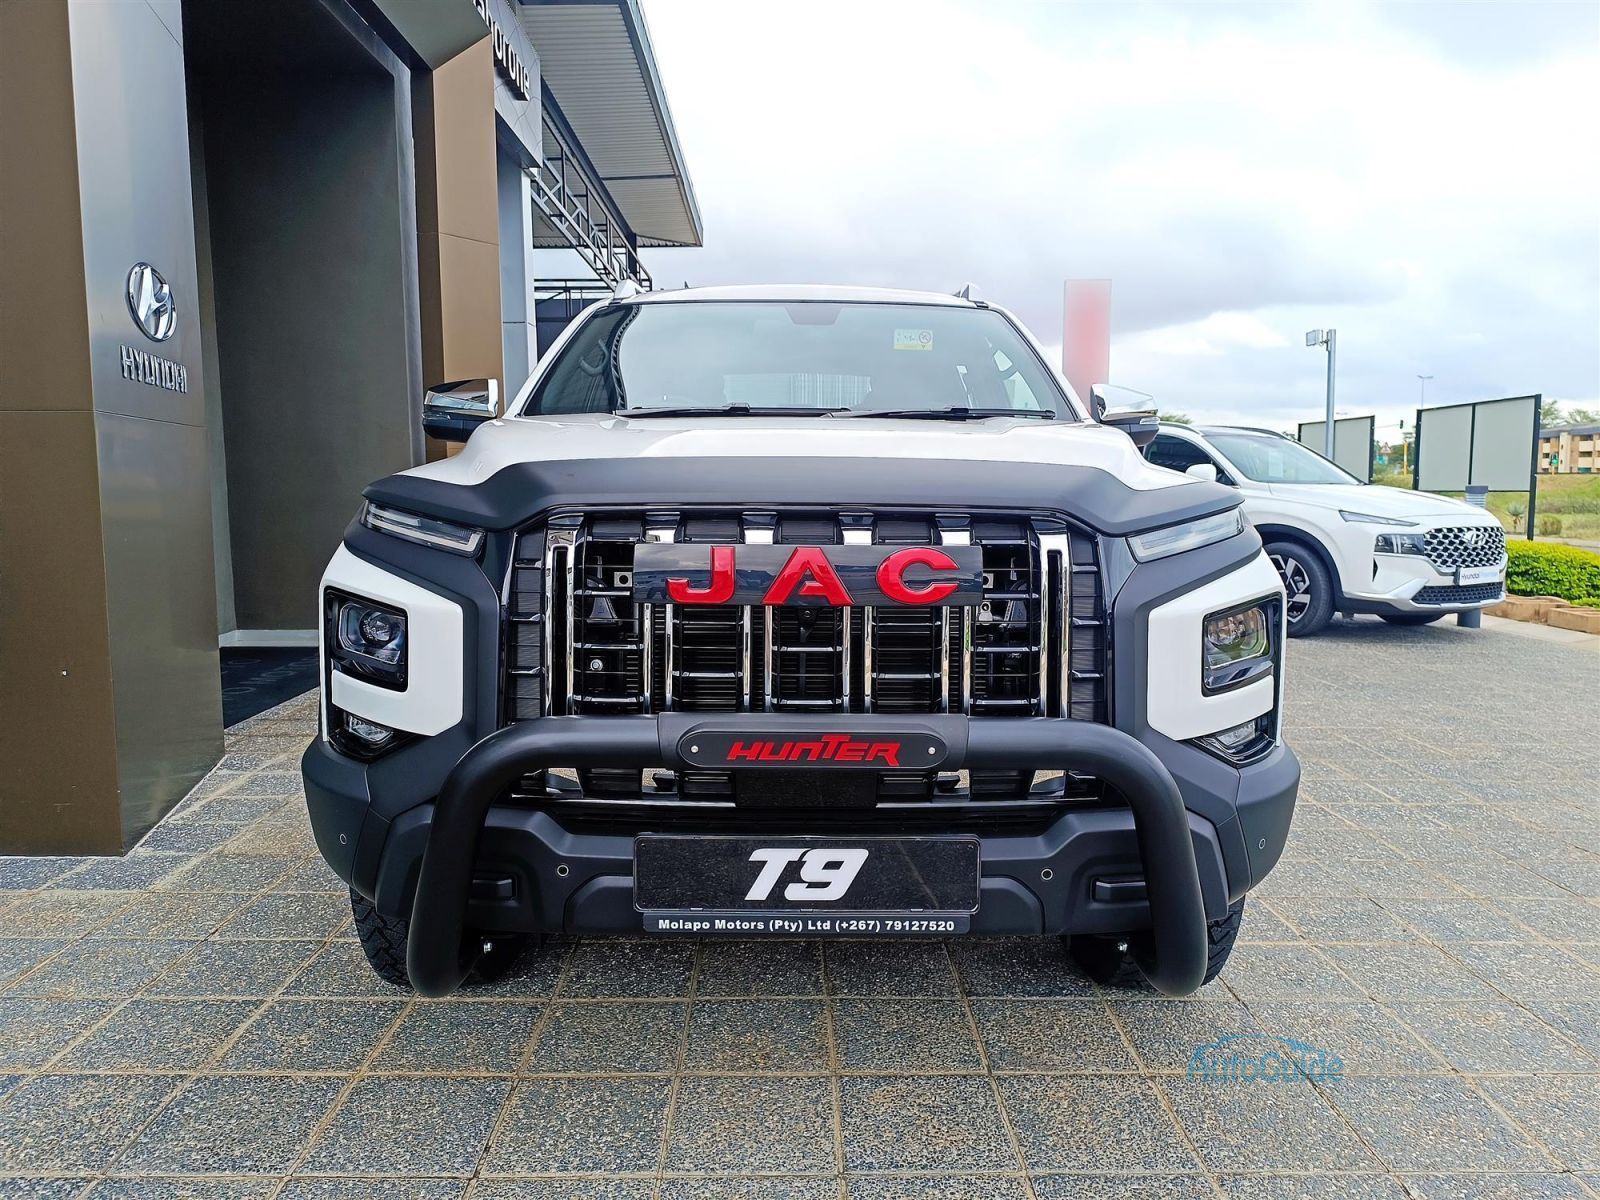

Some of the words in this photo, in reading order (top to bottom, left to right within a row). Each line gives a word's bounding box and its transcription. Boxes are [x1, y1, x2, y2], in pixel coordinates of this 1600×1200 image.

[120, 345, 187, 393] HYUNDAI
[666, 546, 960, 604] JAC
[727, 734, 900, 767] HUNTER
[744, 848, 869, 901] T9
[658, 919, 711, 932] Molapo
[714, 919, 765, 930] Motors
[769, 919, 803, 933] (Pty)
[808, 920, 831, 931] Ltd
[835, 920, 881, 933] (+267)
[885, 920, 955, 931] 79127520
